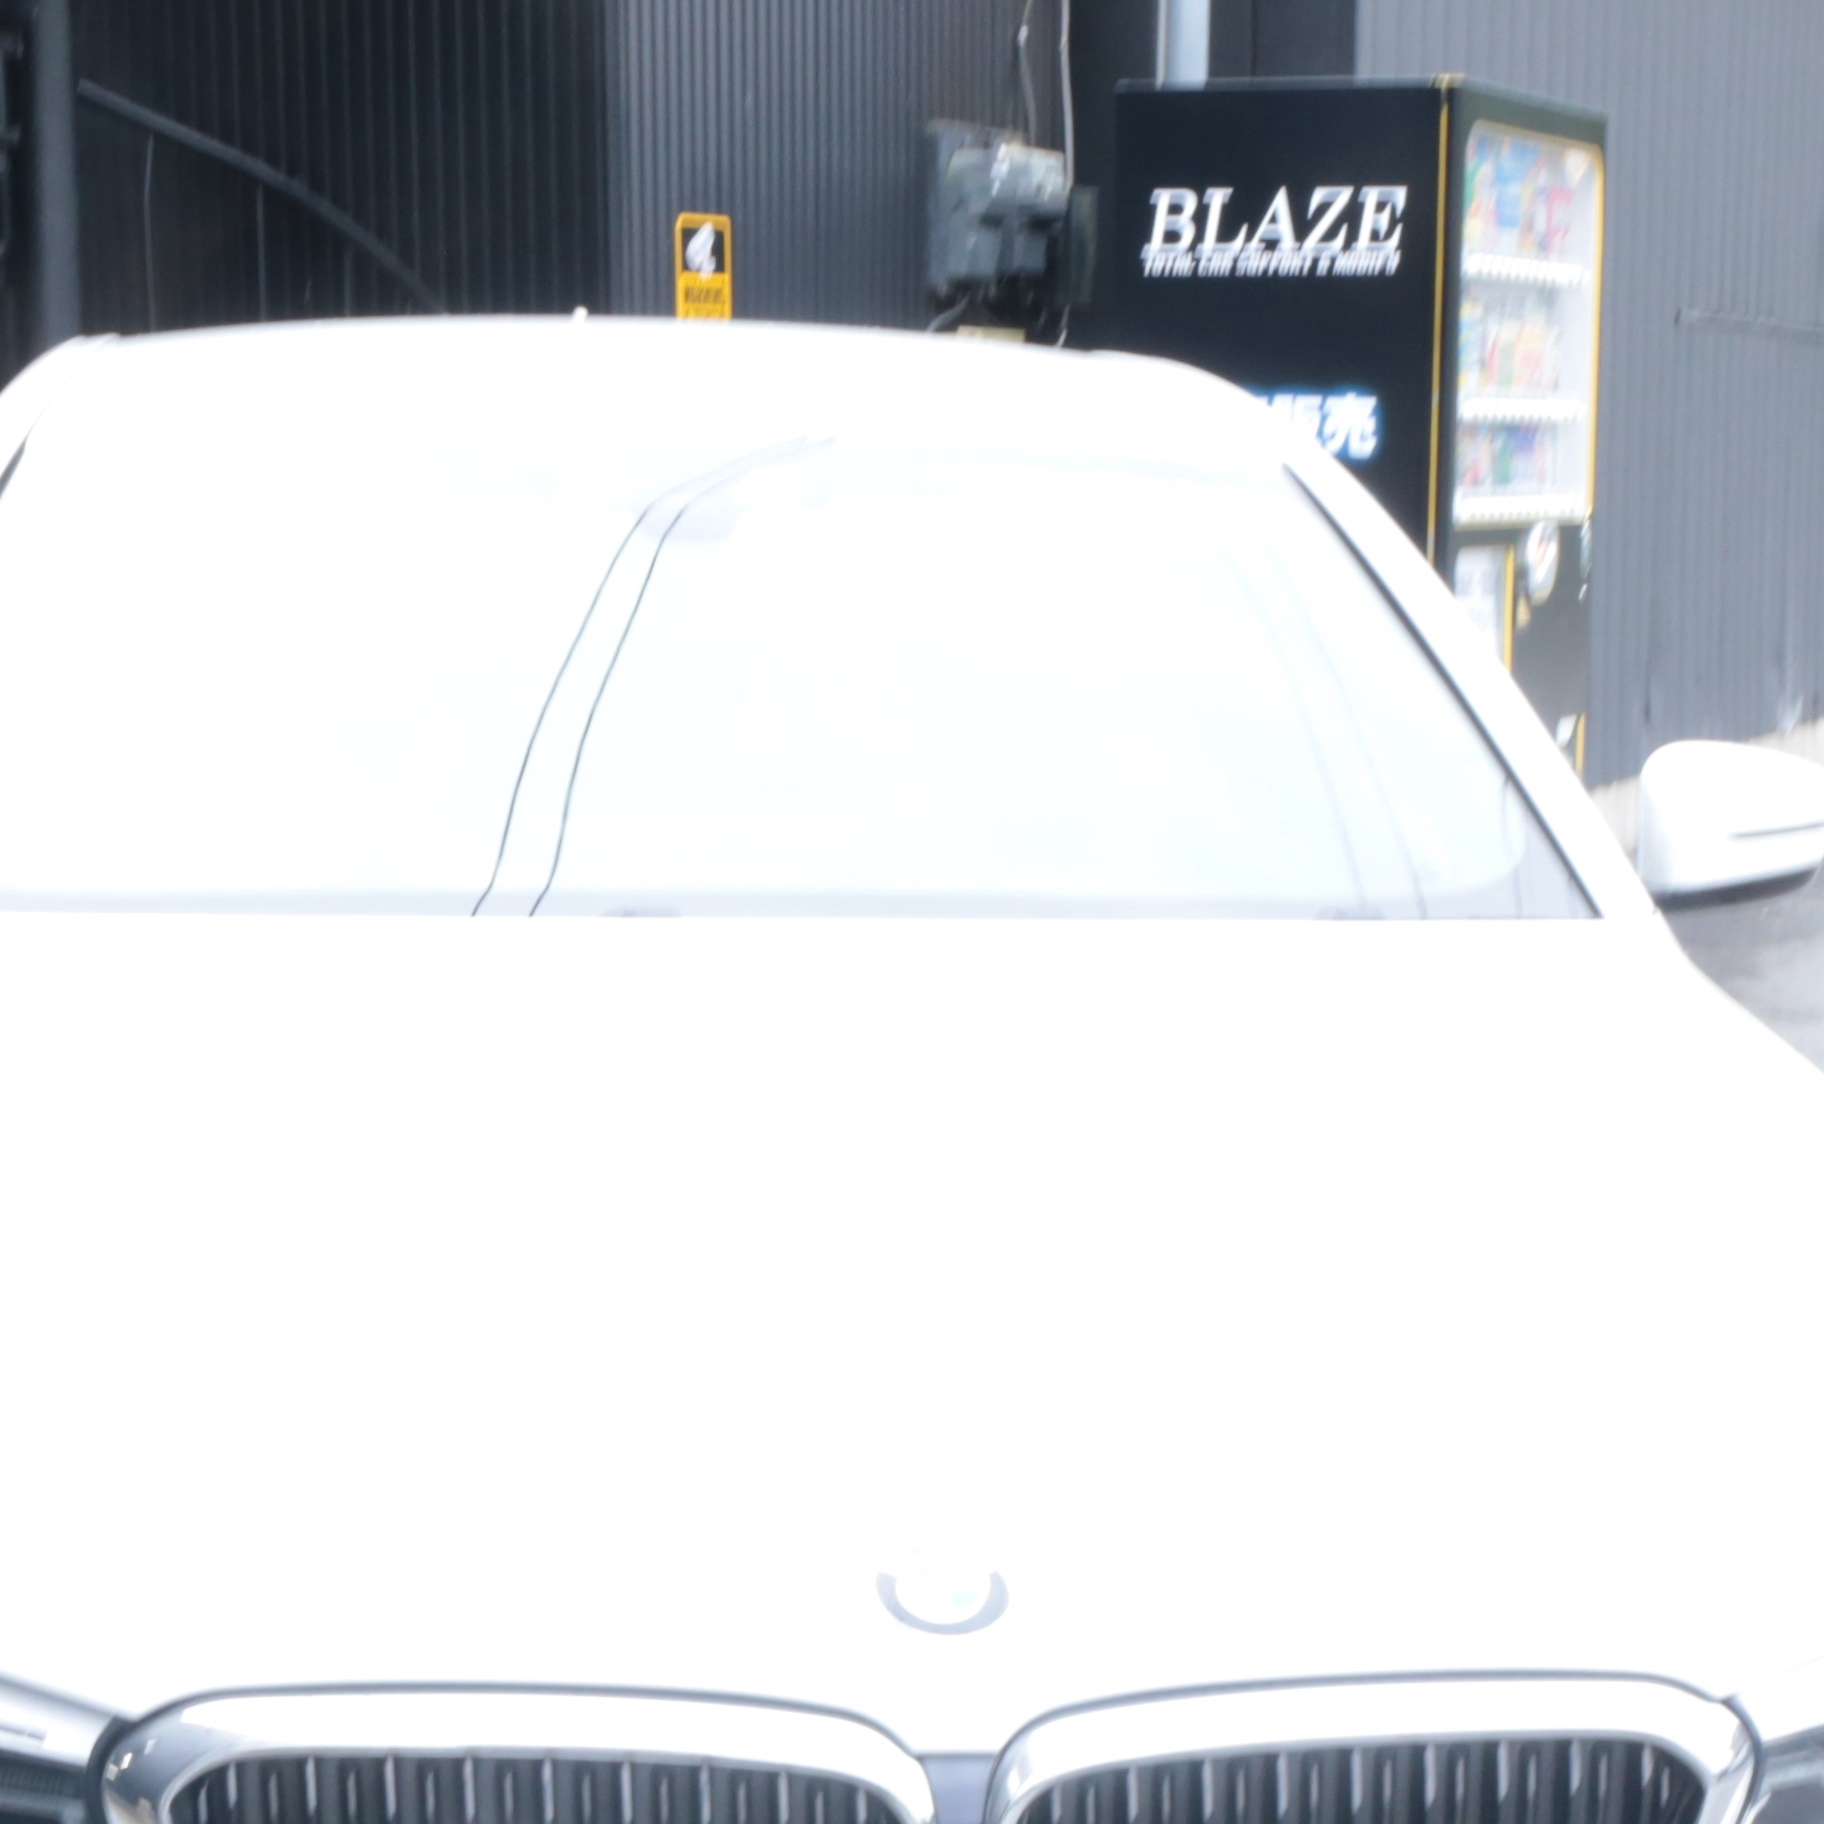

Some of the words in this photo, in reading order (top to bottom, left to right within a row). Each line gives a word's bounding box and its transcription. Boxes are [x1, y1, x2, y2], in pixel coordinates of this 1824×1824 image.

[1141, 185, 1407, 259] BLAZE
[1197, 251, 1233, 278] CAR
[1235, 250, 1314, 278] SUPPORT
